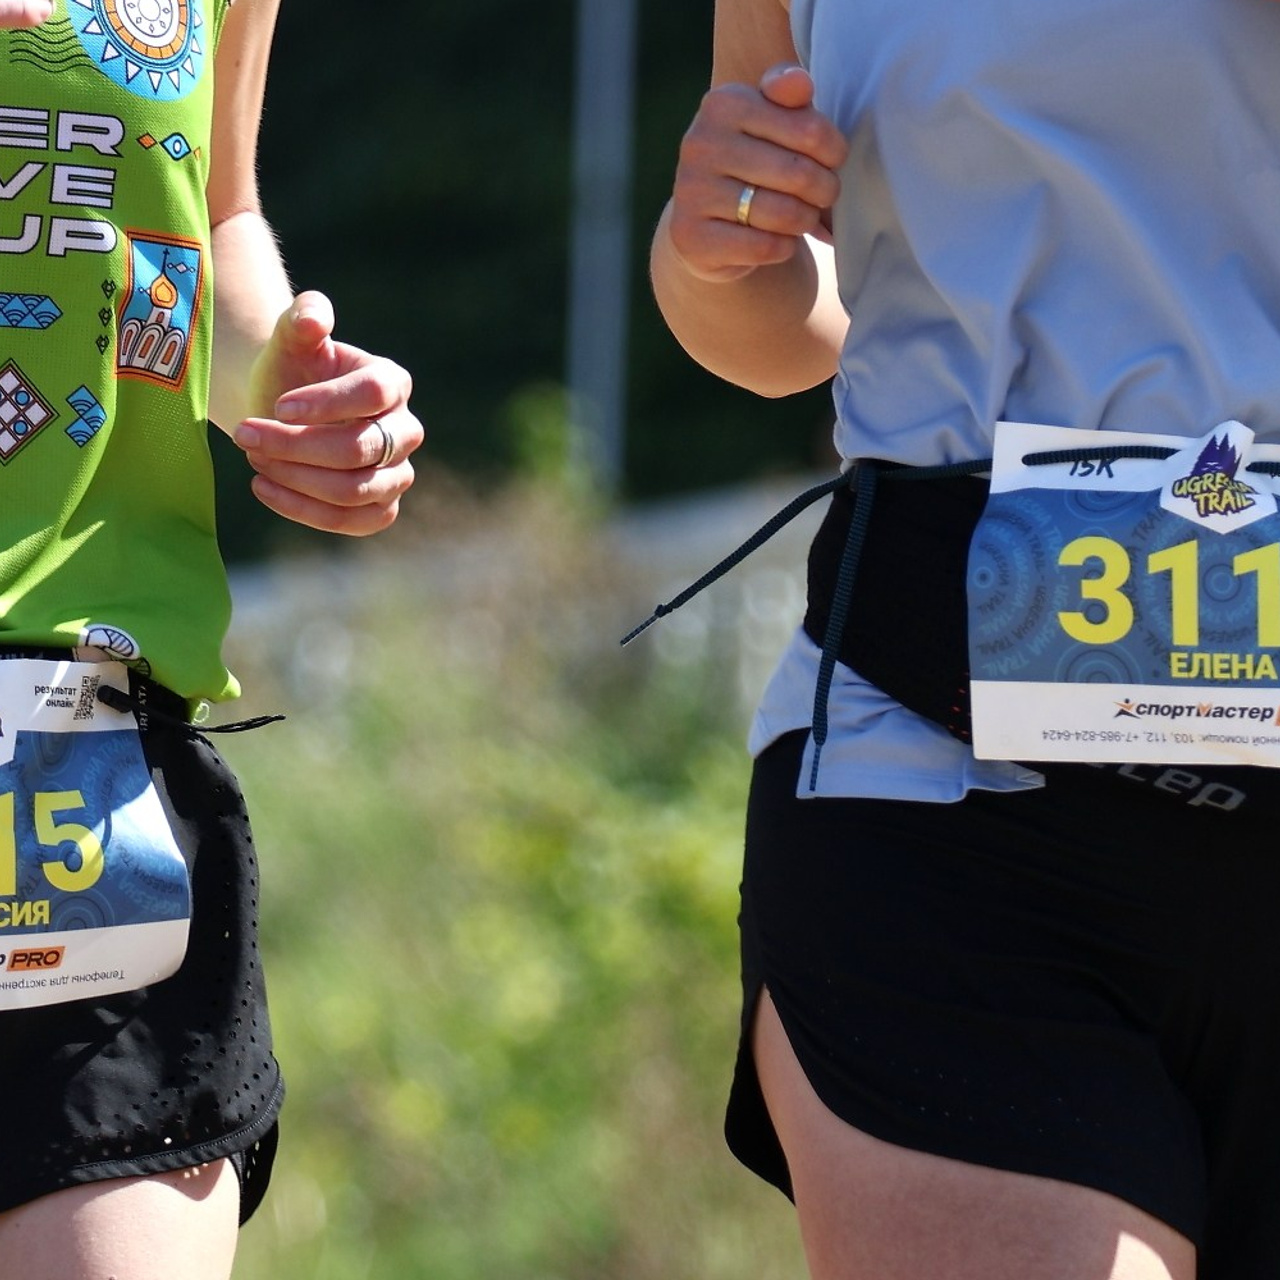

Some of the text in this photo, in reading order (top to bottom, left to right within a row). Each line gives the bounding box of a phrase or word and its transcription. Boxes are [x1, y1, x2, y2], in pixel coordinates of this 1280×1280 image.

[1194, 492, 1256, 518] TRAIL
[1170, 652, 1279, 681] ЕЛЕНА
[34, 684, 77, 697] результат
[9, 949, 61, 969] PRO
